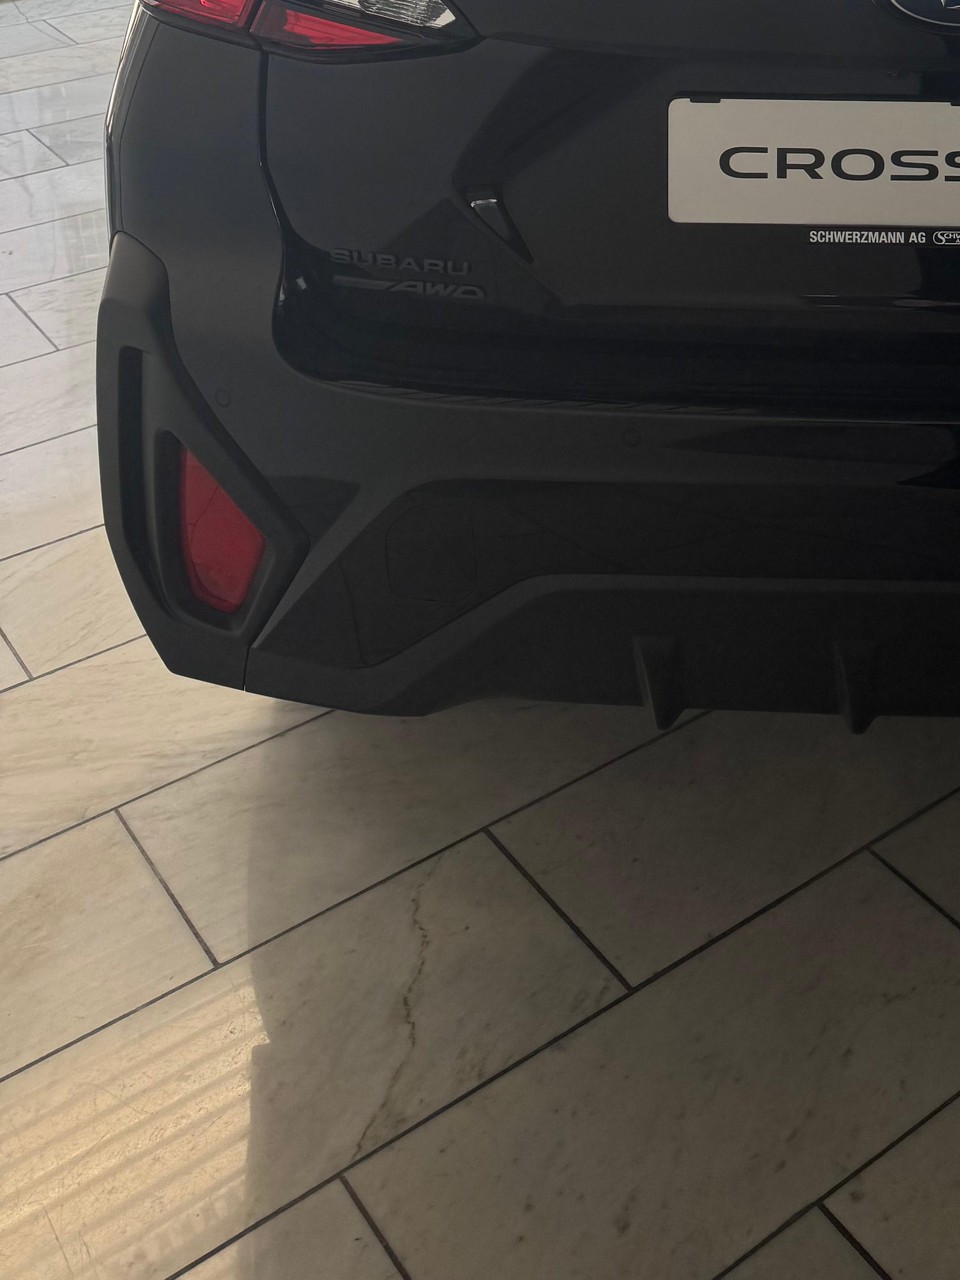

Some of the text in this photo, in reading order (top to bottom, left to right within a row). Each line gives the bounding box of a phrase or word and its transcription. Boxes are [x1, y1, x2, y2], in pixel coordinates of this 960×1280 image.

[809, 230, 926, 244] SCHWERZMANN AG
[331, 248, 469, 275] SUBARU
[388, 280, 485, 299] AWD
